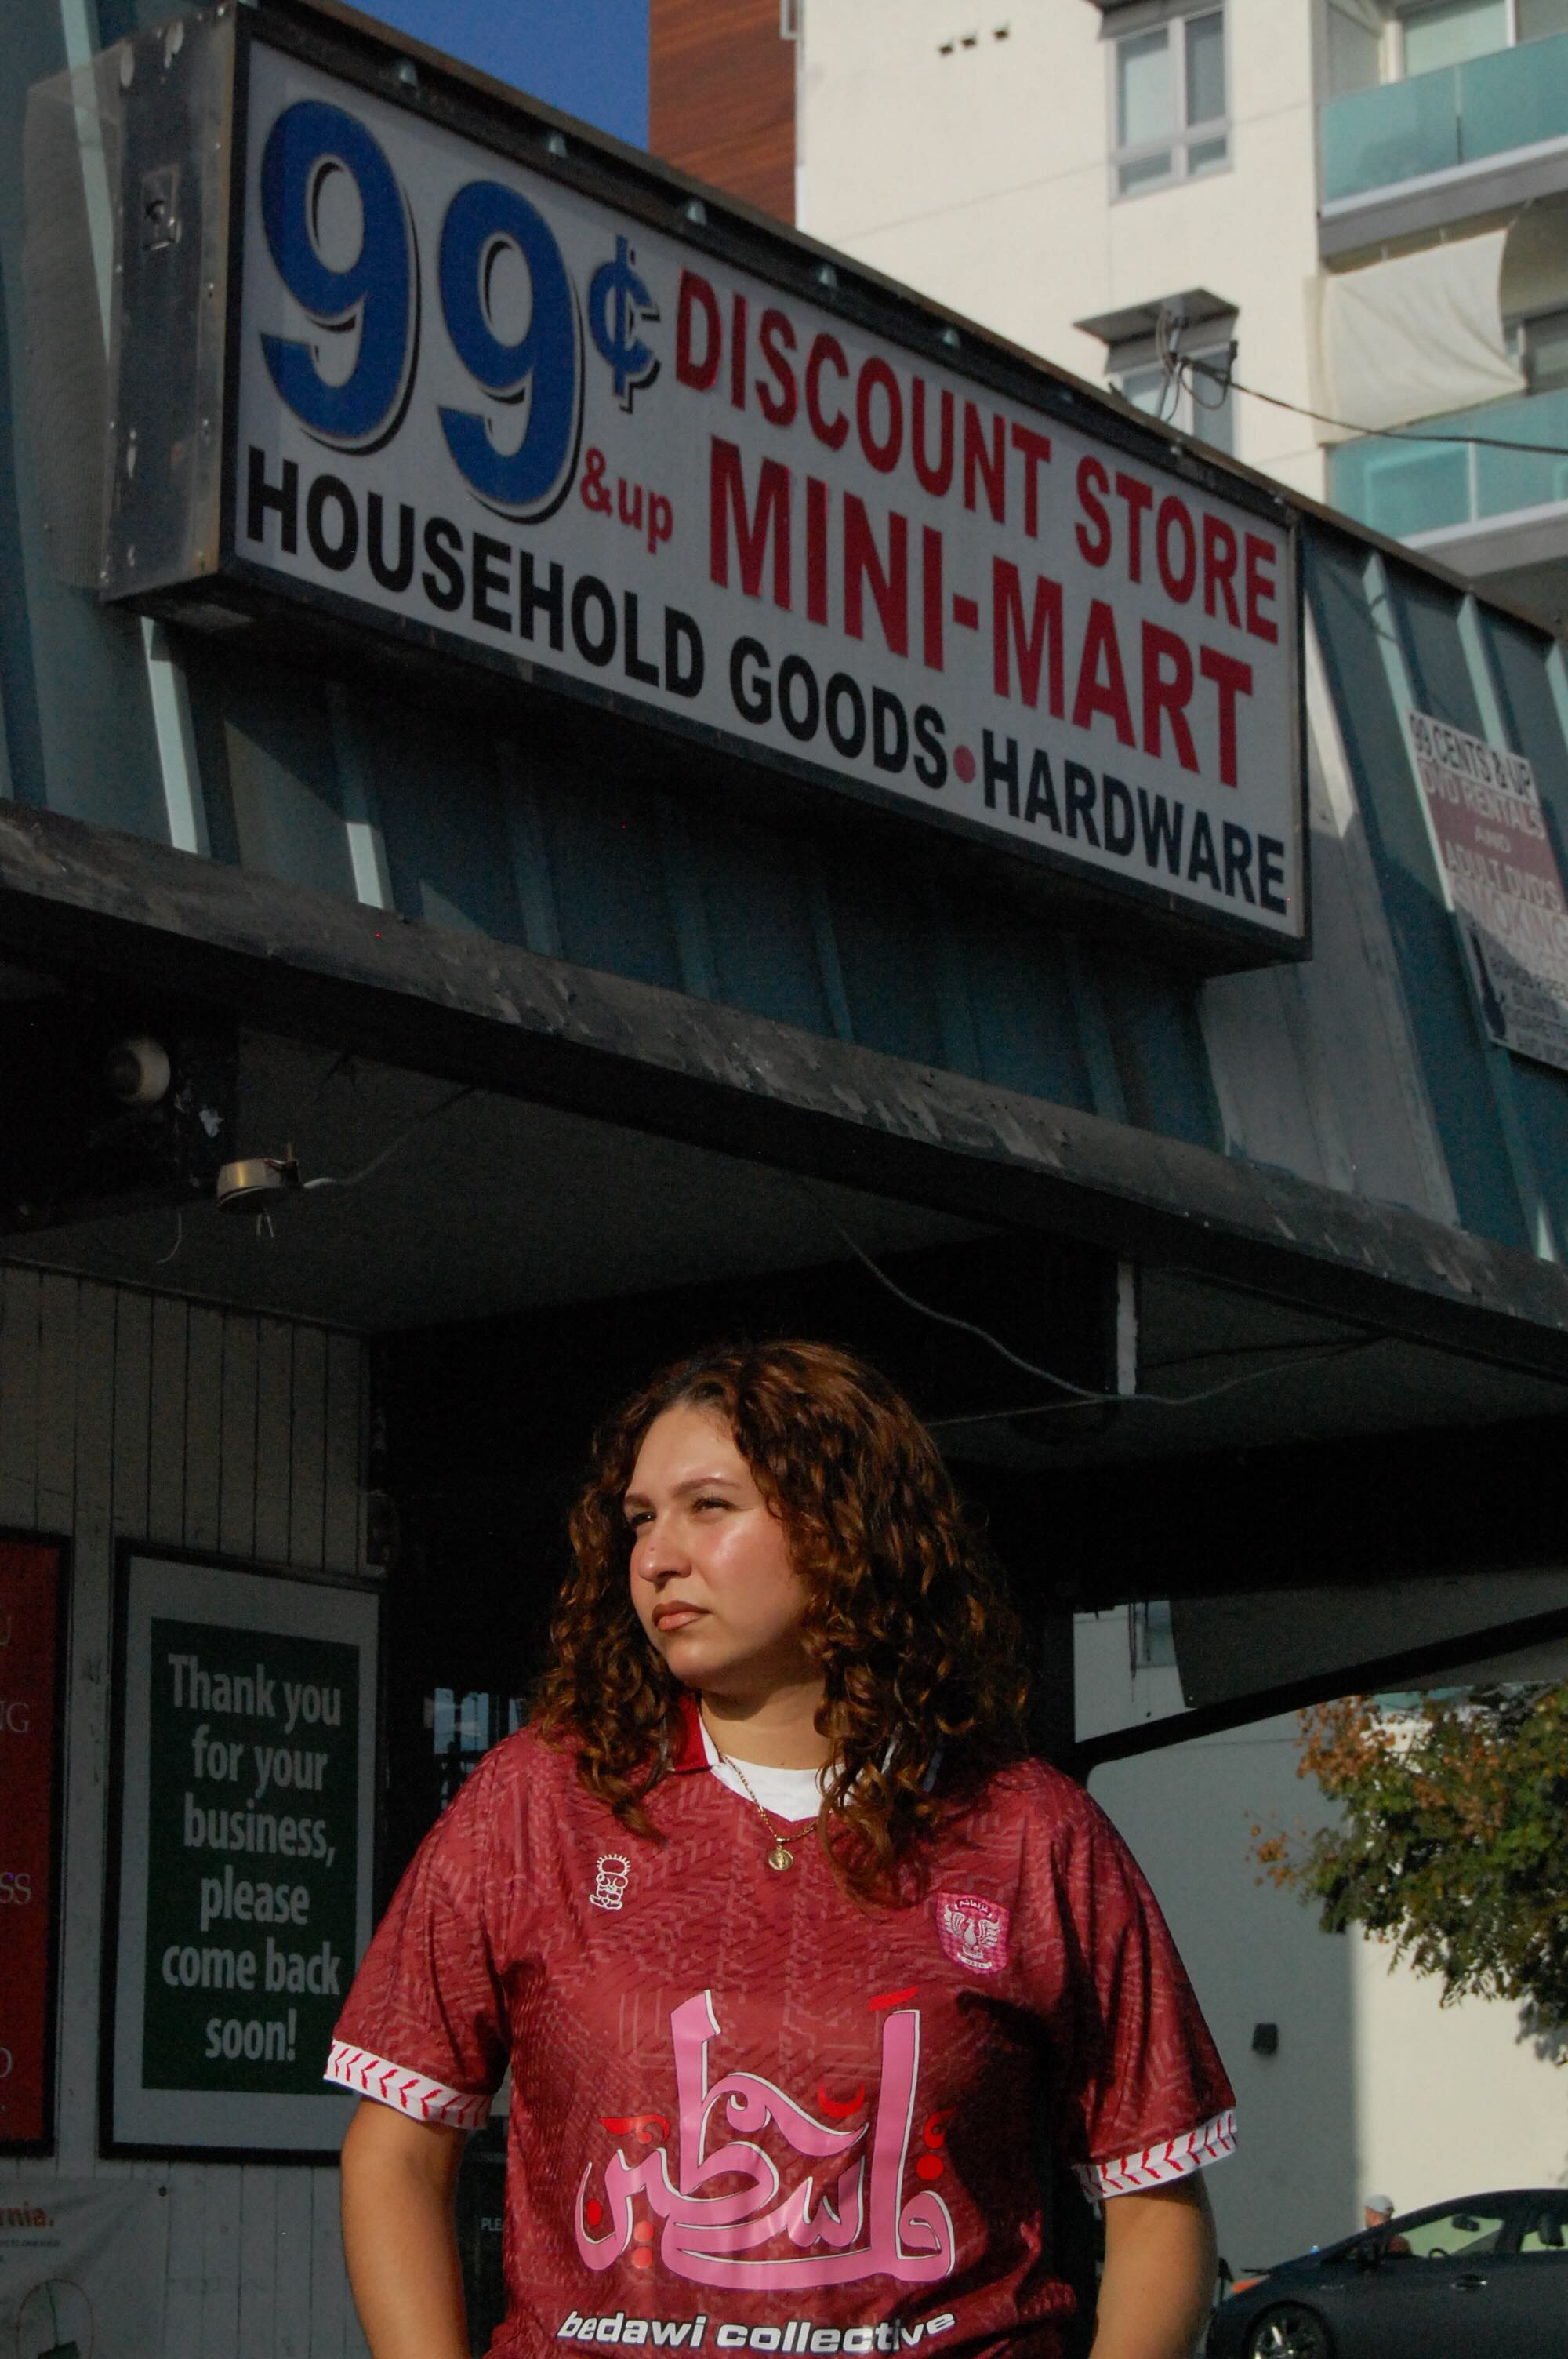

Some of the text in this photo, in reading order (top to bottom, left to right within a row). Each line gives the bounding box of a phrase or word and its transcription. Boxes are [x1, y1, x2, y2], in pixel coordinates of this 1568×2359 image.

[675, 264, 1279, 645] DISCOUNT STORE
[709, 434, 1254, 789] MINI-MART
[246, 445, 1288, 916] HOUSEHOLD GOODS HARDWARE
[1432, 725, 1492, 784] CENTS
[1506, 756, 1533, 801] UP
[1420, 763, 1546, 840] DVD RENTALS
[167, 1652, 342, 1735] Thank you
[191, 1725, 328, 1799] for your
[183, 1792, 336, 1867] business,
[201, 1864, 310, 1932] please
[161, 1936, 341, 1995] come back
[205, 2008, 297, 2062] soon!
[557, 2310, 956, 2352] bedawi collective
